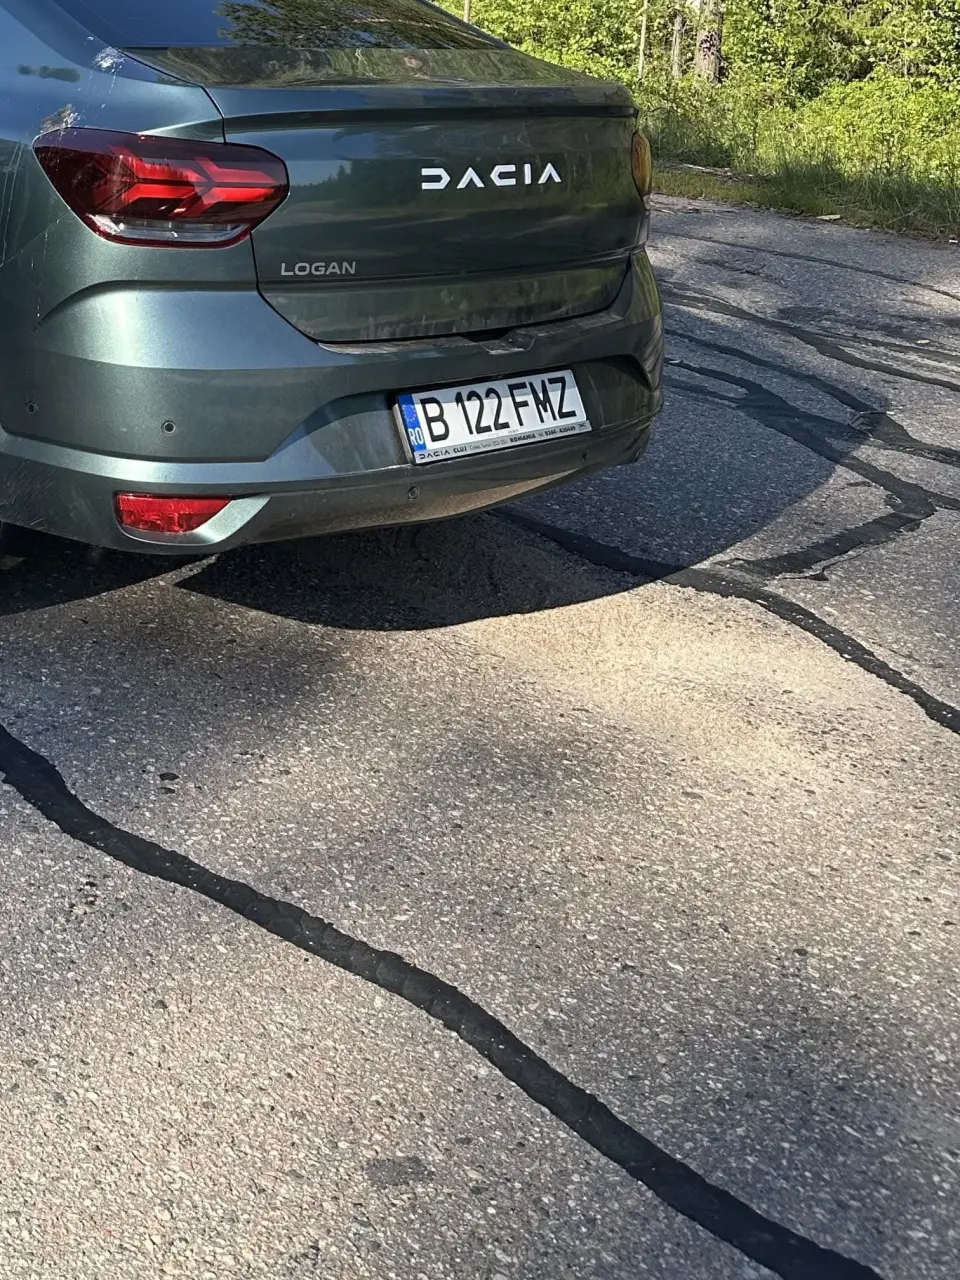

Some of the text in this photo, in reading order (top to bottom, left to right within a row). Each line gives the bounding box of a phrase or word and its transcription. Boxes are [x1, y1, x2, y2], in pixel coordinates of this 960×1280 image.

[421, 163, 562, 190] DACIA
[280, 261, 357, 277] LOGAN
[420, 376, 577, 442] B 122 FMZ
[409, 426, 425, 446] RO
[419, 449, 451, 460] DACIA
[453, 445, 467, 454] CLUJ
[509, 433, 537, 443] ROMANIA
